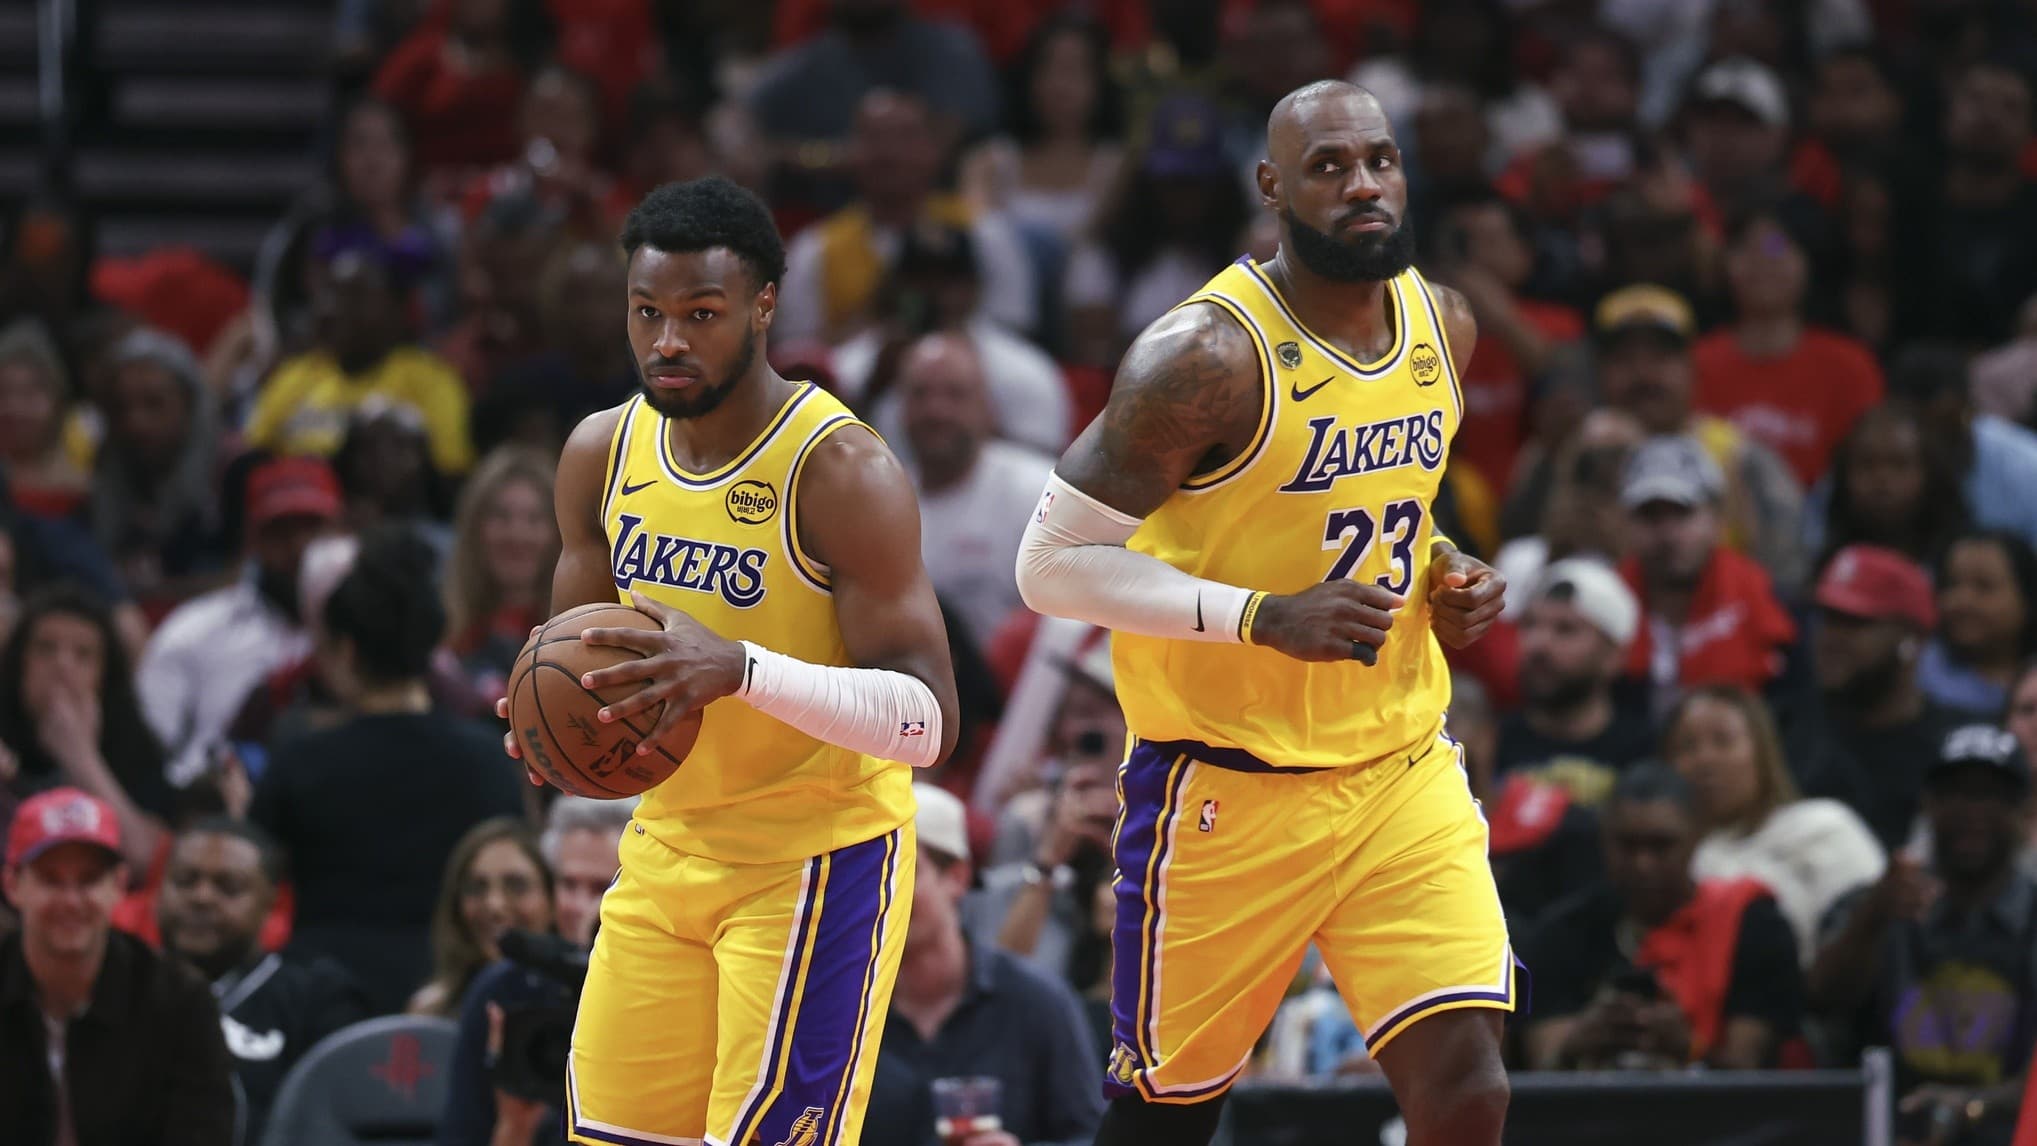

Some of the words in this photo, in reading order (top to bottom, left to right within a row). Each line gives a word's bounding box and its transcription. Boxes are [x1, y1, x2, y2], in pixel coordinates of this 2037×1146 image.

[1276, 409, 1444, 493] LAKERS
[731, 490, 774, 513] bibigo
[612, 513, 770, 609] LAKERS
[1321, 496, 1425, 600] 23
